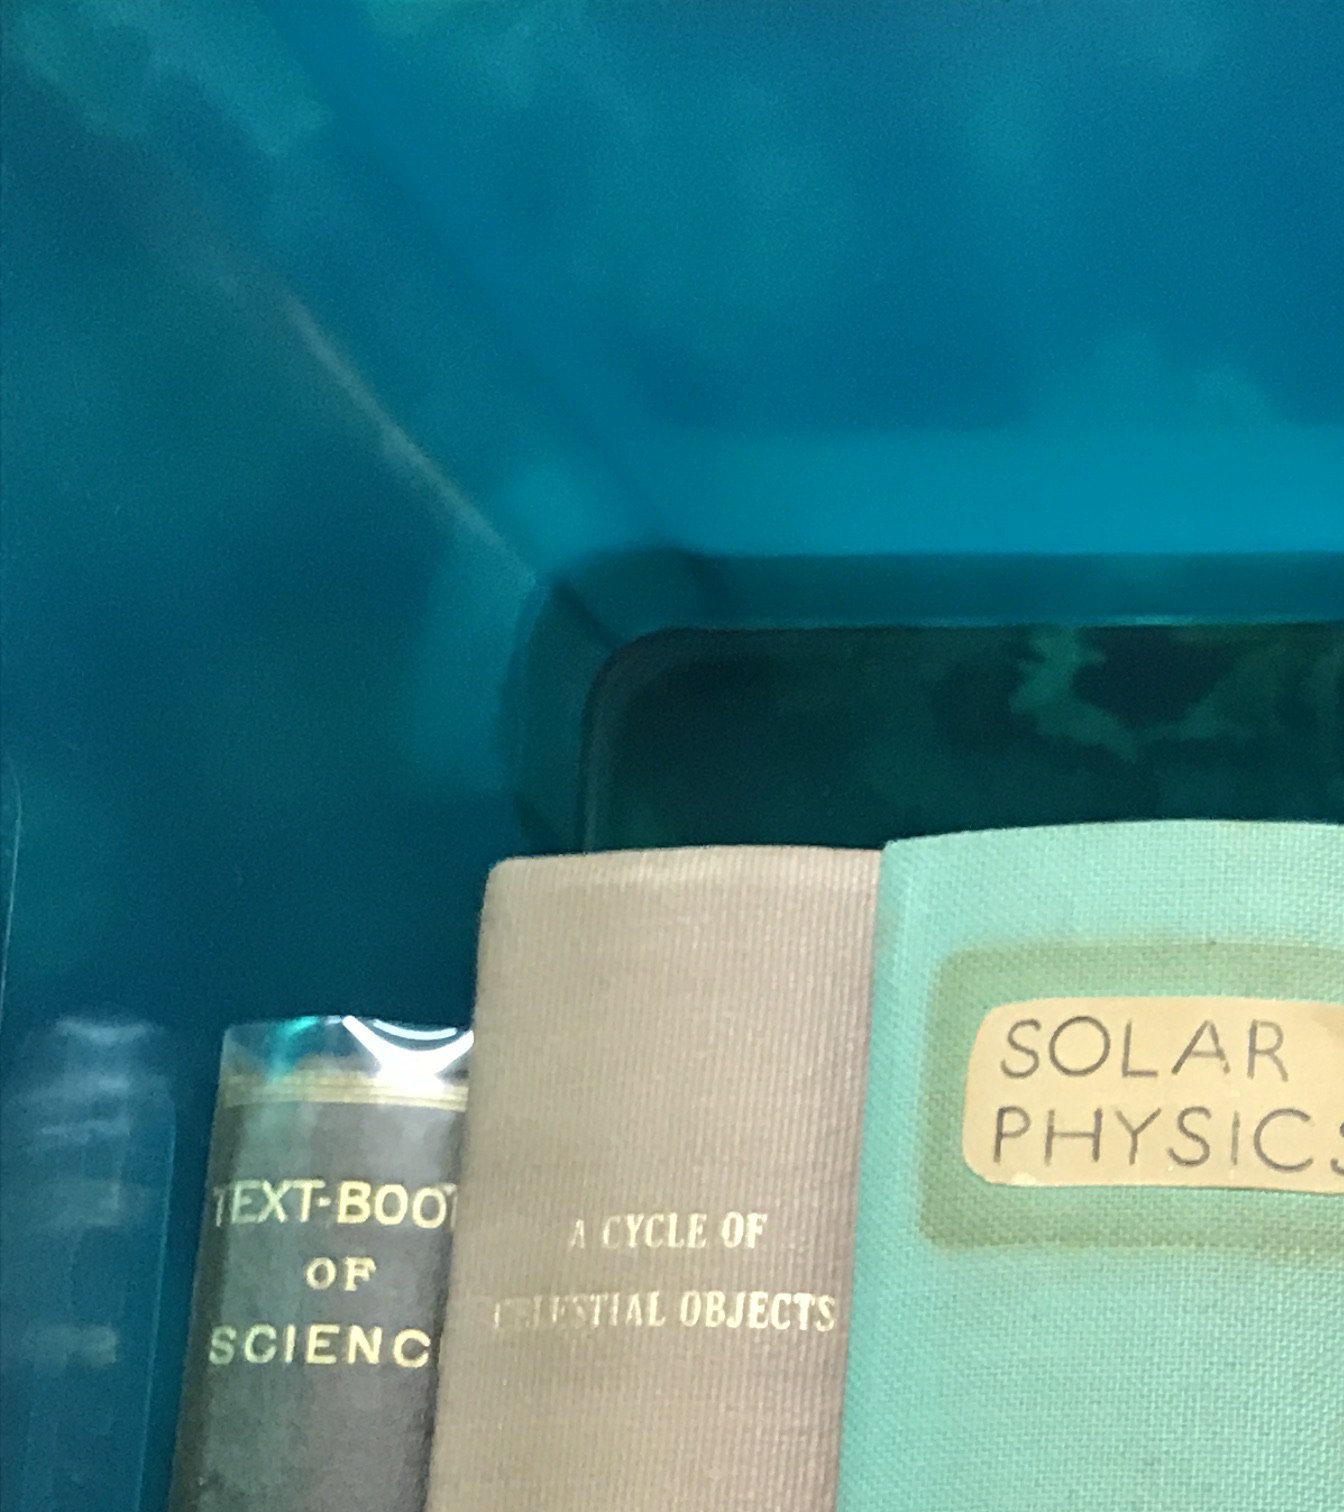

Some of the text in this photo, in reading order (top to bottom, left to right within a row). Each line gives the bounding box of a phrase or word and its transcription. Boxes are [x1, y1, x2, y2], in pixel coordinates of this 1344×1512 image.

[1000, 1015, 1290, 1082] SOLAR
[212, 1178, 458, 1230] TEXT-BOO
[568, 1211, 769, 1249] A CYCLE OF
[305, 1256, 377, 1292] OF
[679, 1290, 836, 1332] OBJECTS
